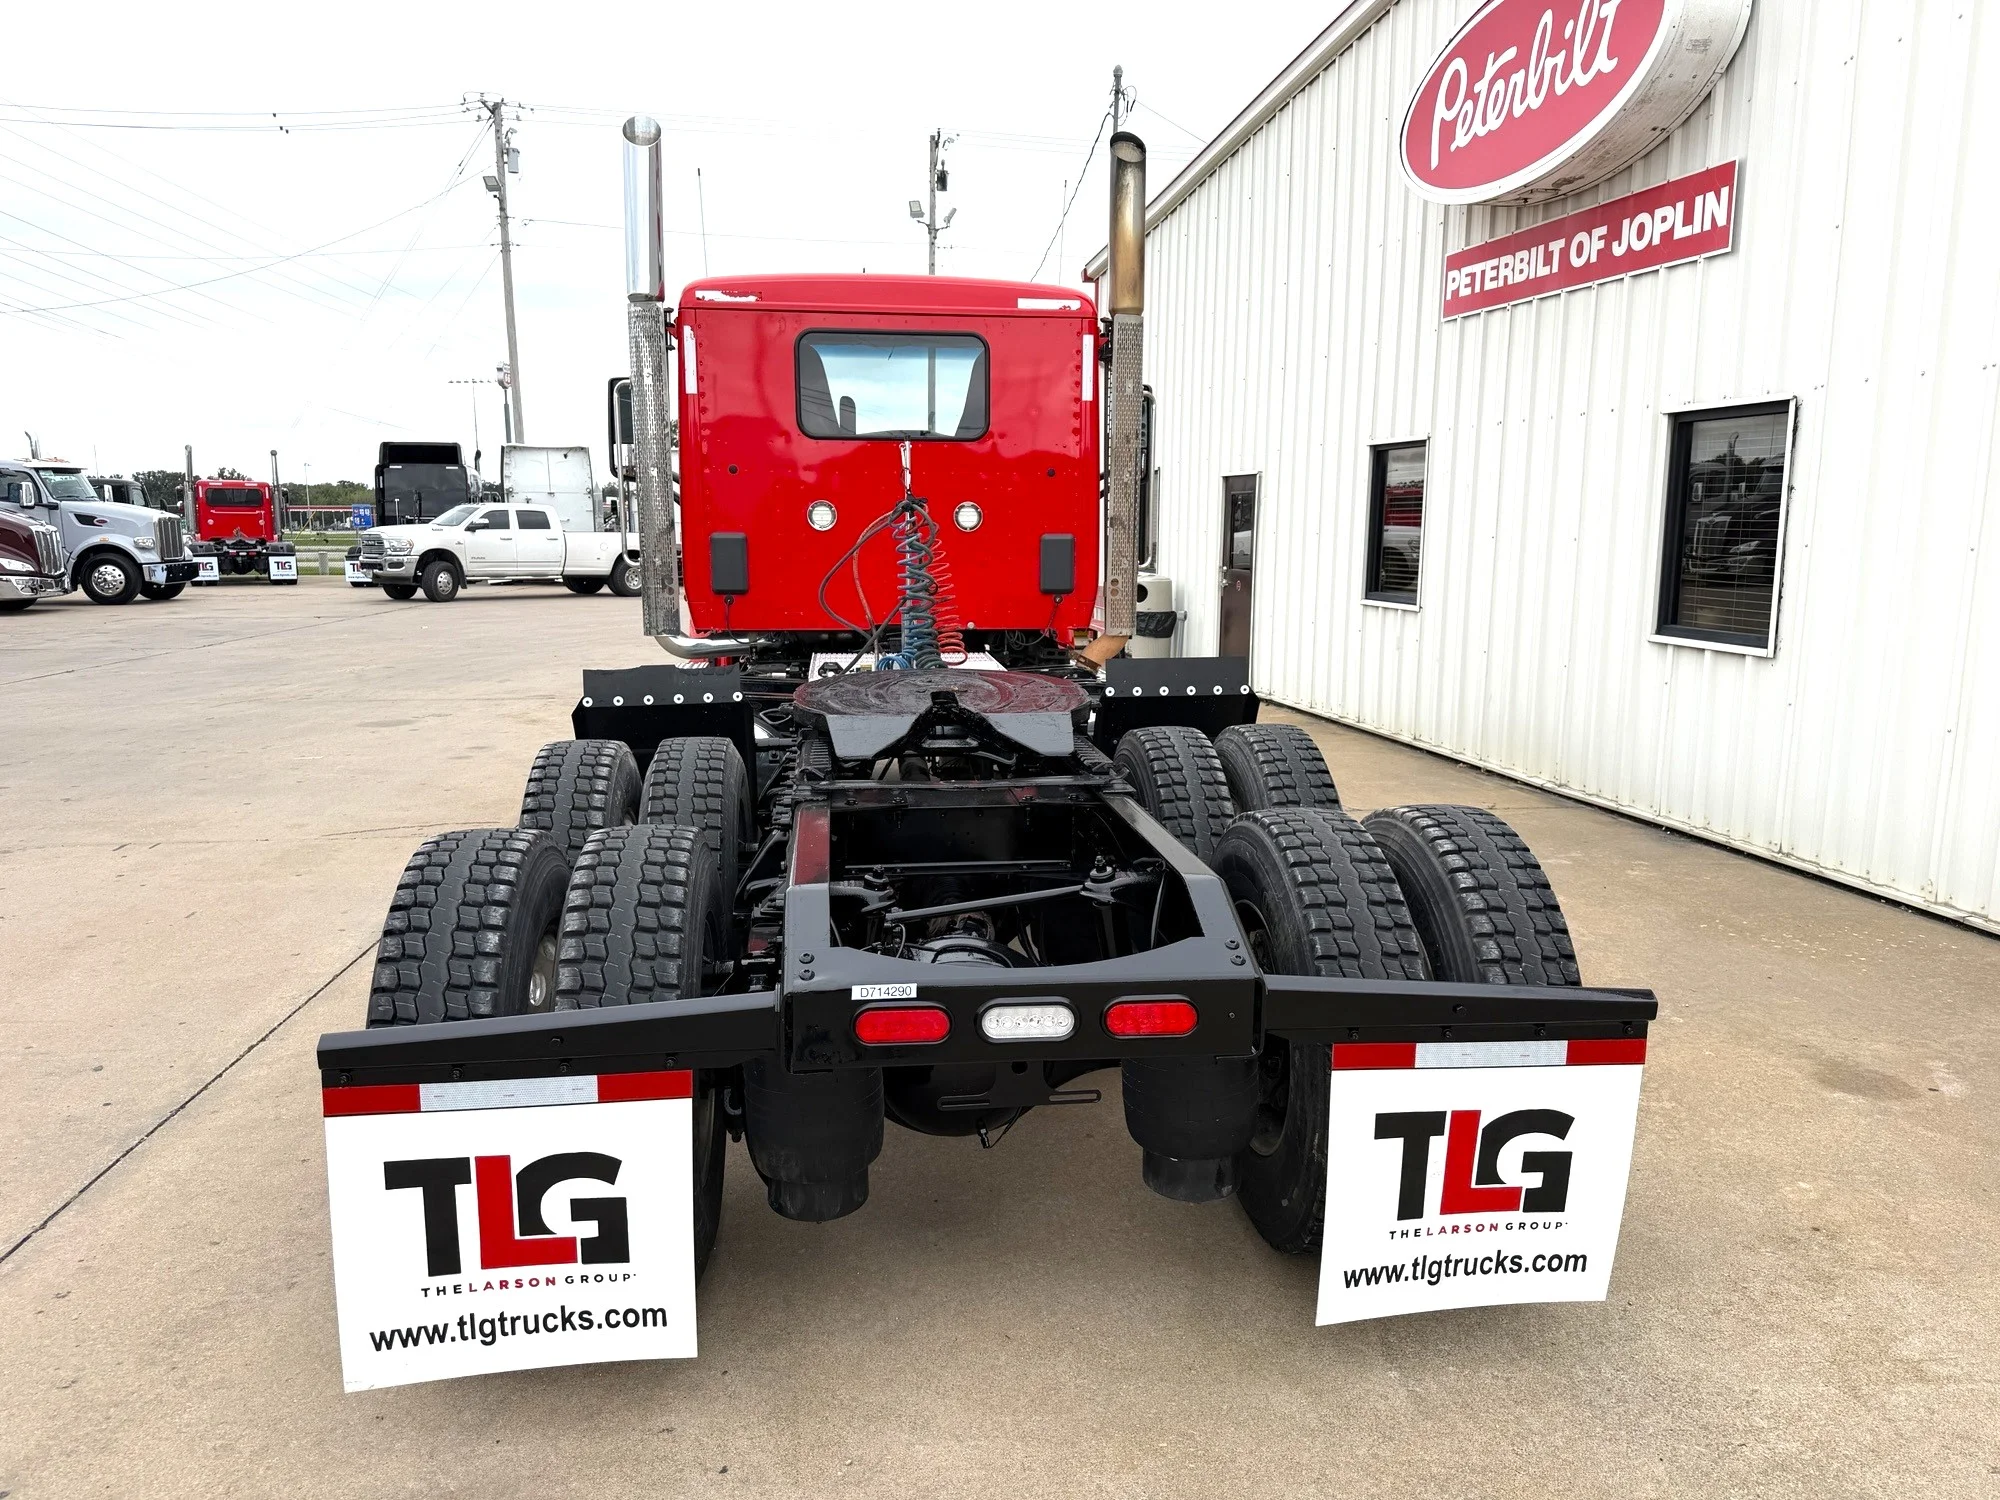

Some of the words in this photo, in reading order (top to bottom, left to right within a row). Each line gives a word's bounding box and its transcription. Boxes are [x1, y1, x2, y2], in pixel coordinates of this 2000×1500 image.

[1430, 0, 1622, 171] Peterbilt
[1446, 237, 1566, 300] PETERBILT
[1569, 226, 1608, 268] OF
[1612, 186, 1731, 257] JOPLIN
[274, 561, 292, 570] TLG
[860, 985, 912, 998] D714290
[1374, 1108, 1575, 1221] TLG
[383, 1151, 630, 1277] TLG
[1426, 1223, 1499, 1237] LARSON
[1505, 1222, 1563, 1231] GROUP
[469, 1277, 556, 1293] LARSON
[565, 1273, 632, 1285] GROUP
[1344, 1249, 1588, 1288] www.tlgtrucks.com
[369, 1305, 668, 1352] www.tlgtrucks.com
